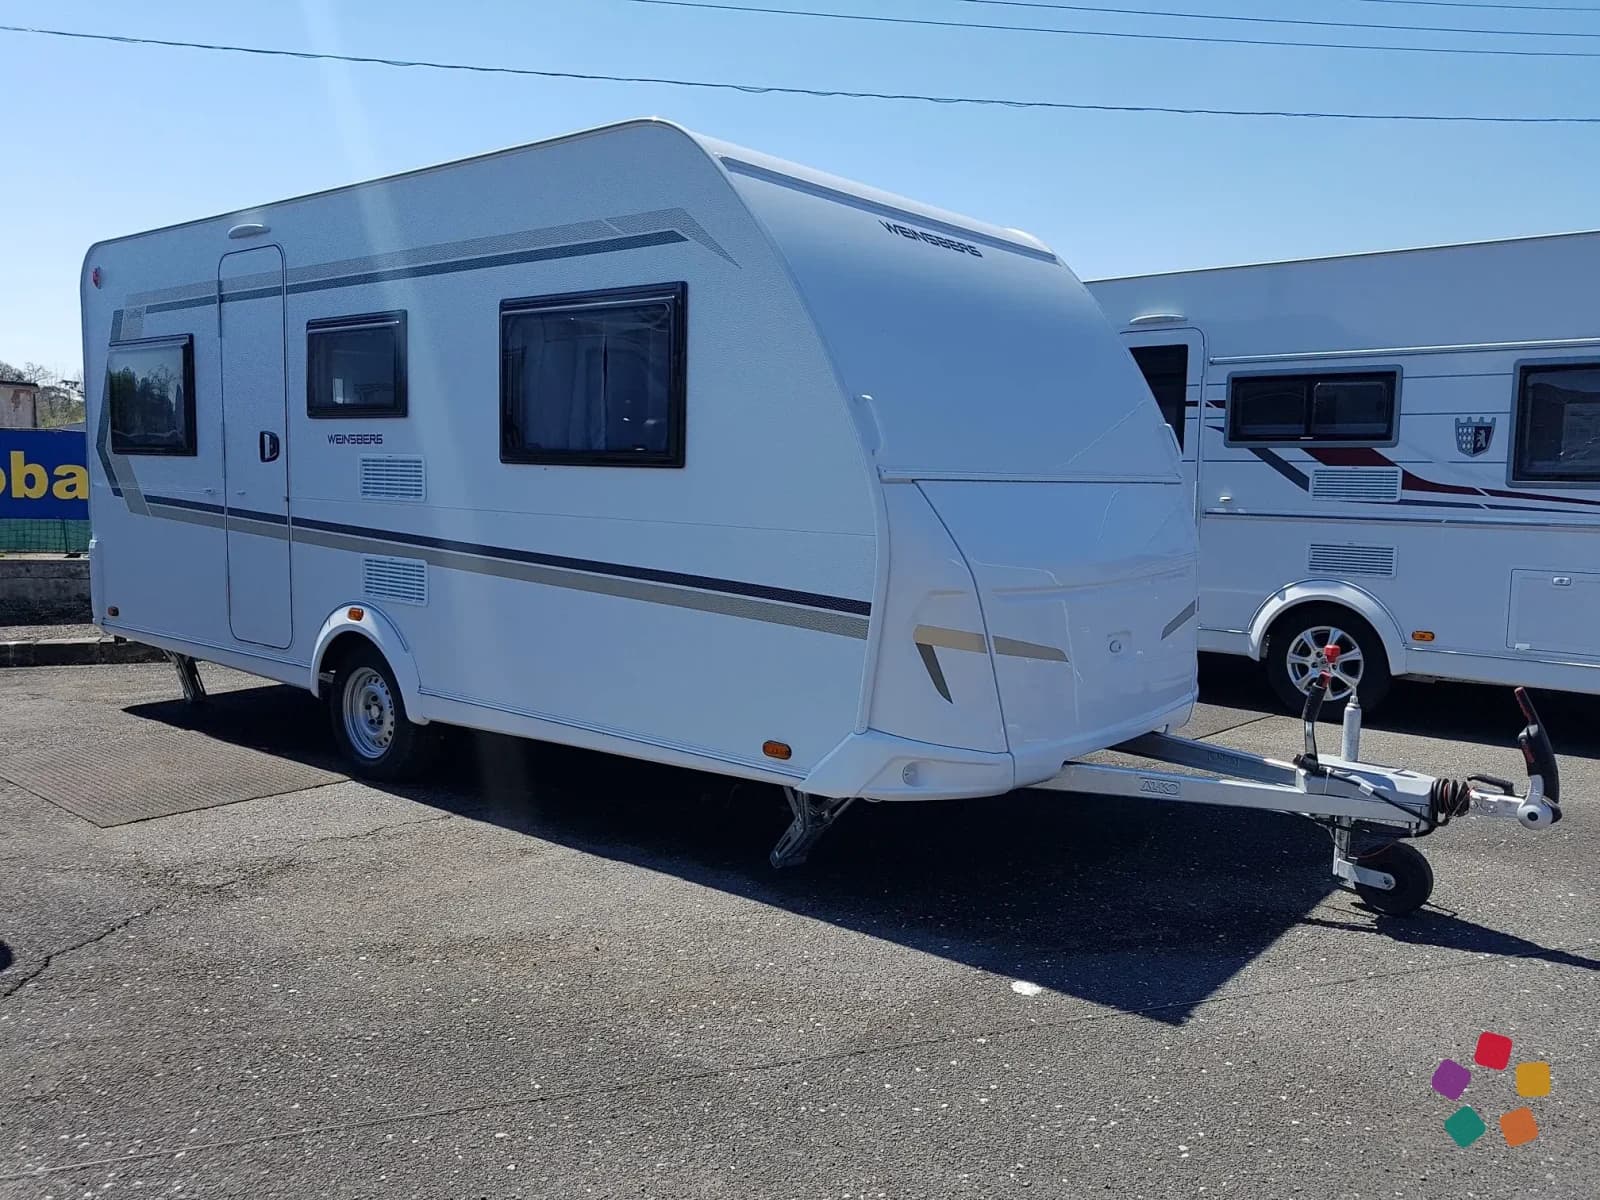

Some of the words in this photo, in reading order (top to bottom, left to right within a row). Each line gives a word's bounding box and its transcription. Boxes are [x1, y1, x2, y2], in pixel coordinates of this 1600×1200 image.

[878, 219, 984, 258] WEINSBERG
[327, 433, 383, 445] WEINSBERG
[0, 450, 88, 500] ba
